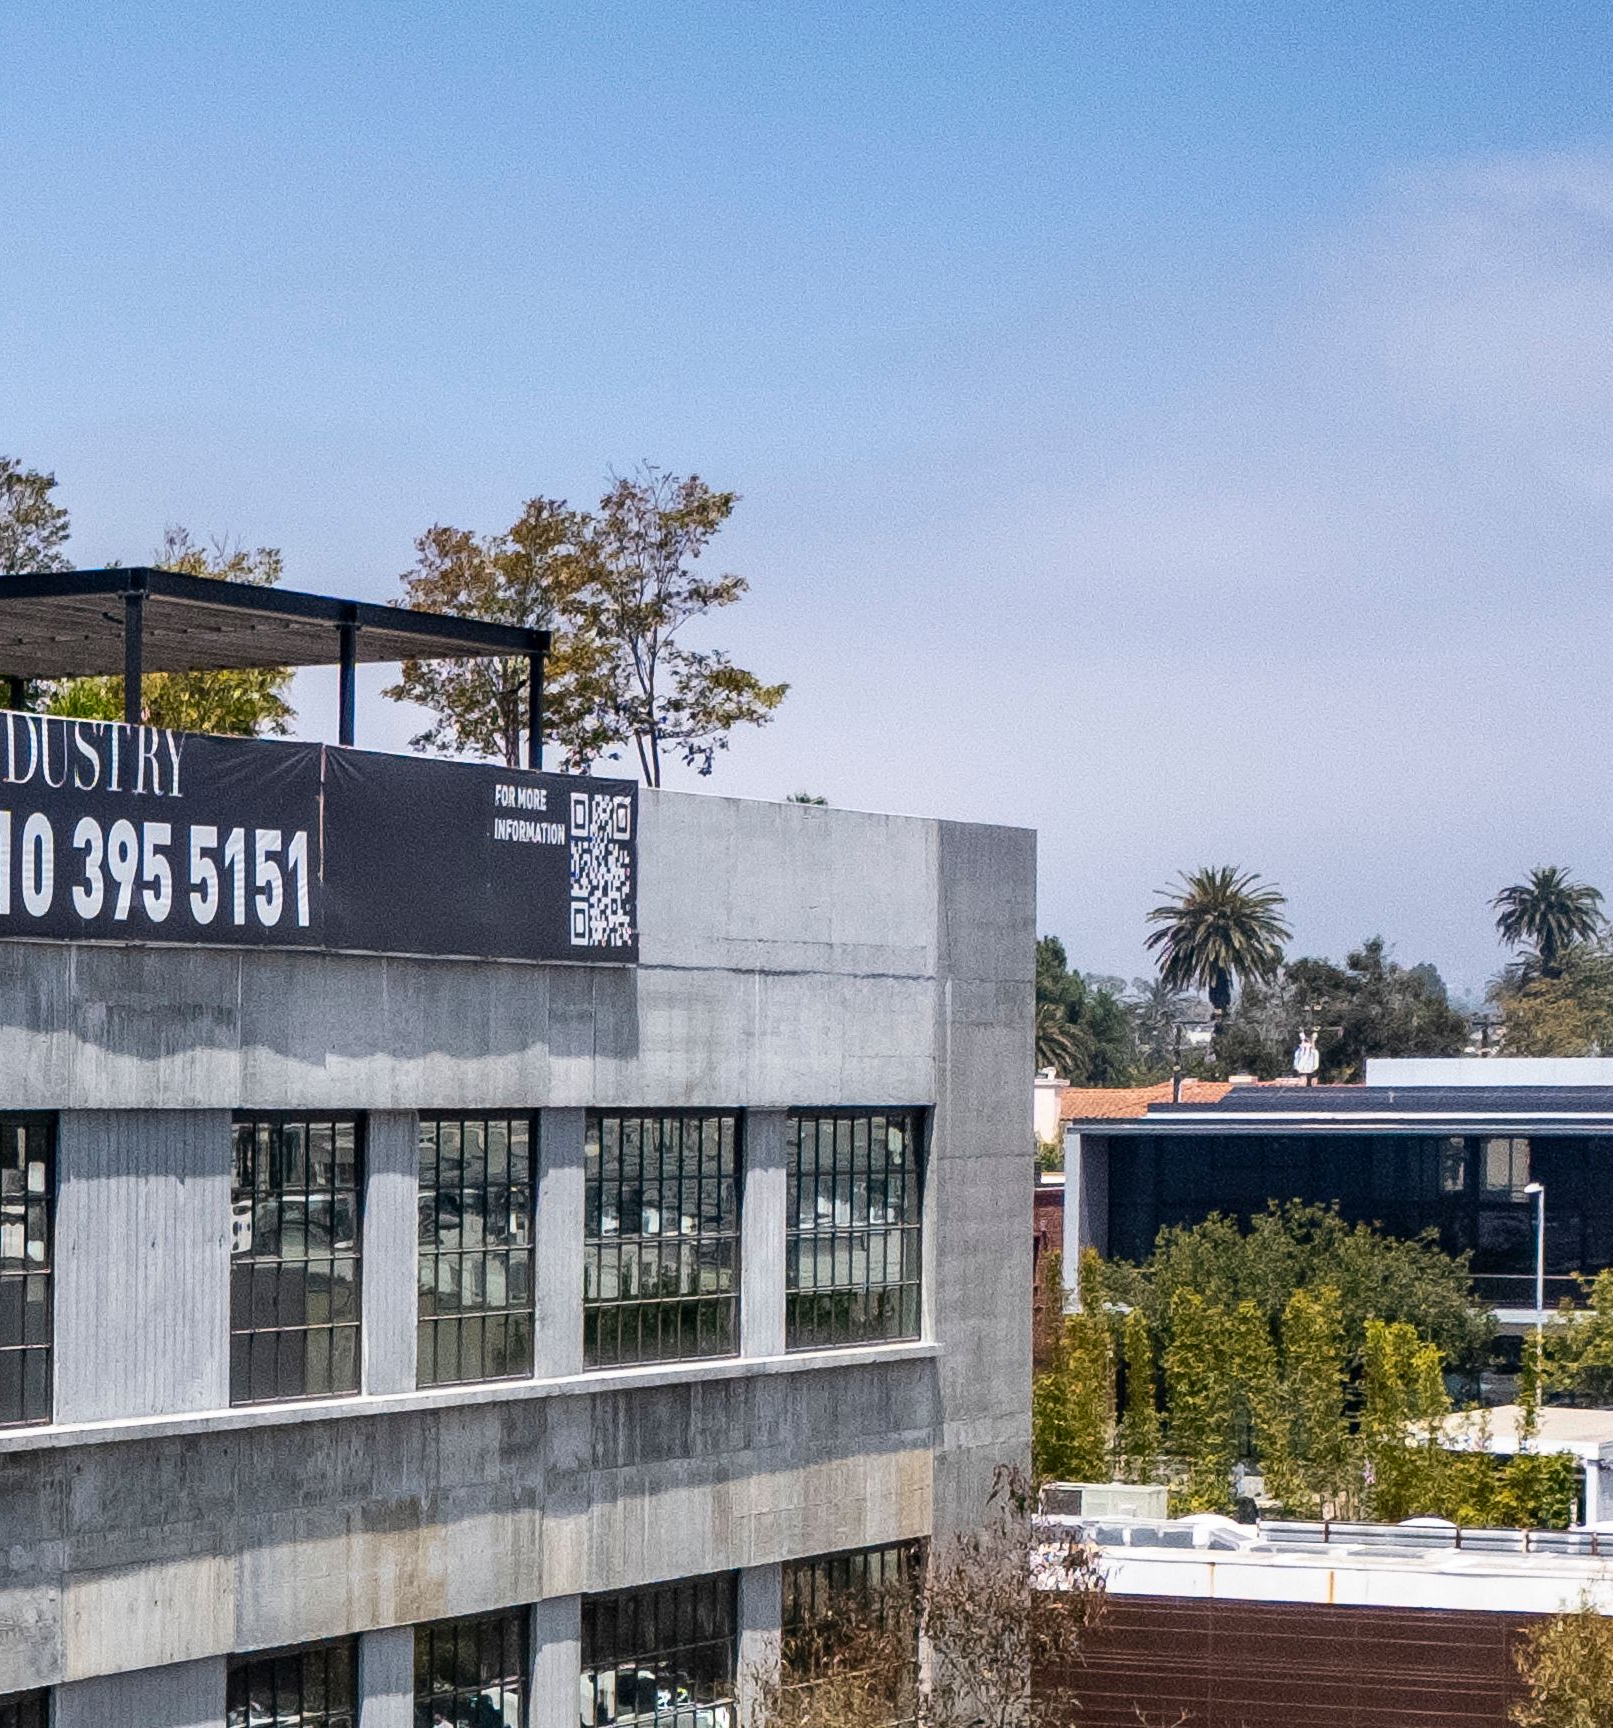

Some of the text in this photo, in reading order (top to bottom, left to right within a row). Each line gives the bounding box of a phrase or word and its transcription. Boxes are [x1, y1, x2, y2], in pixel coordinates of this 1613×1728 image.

[495, 785, 547, 811] FOR MORE
[494, 818, 566, 845] INFORMATION
[72, 817, 172, 922] 395
[190, 825, 309, 927] 5151
